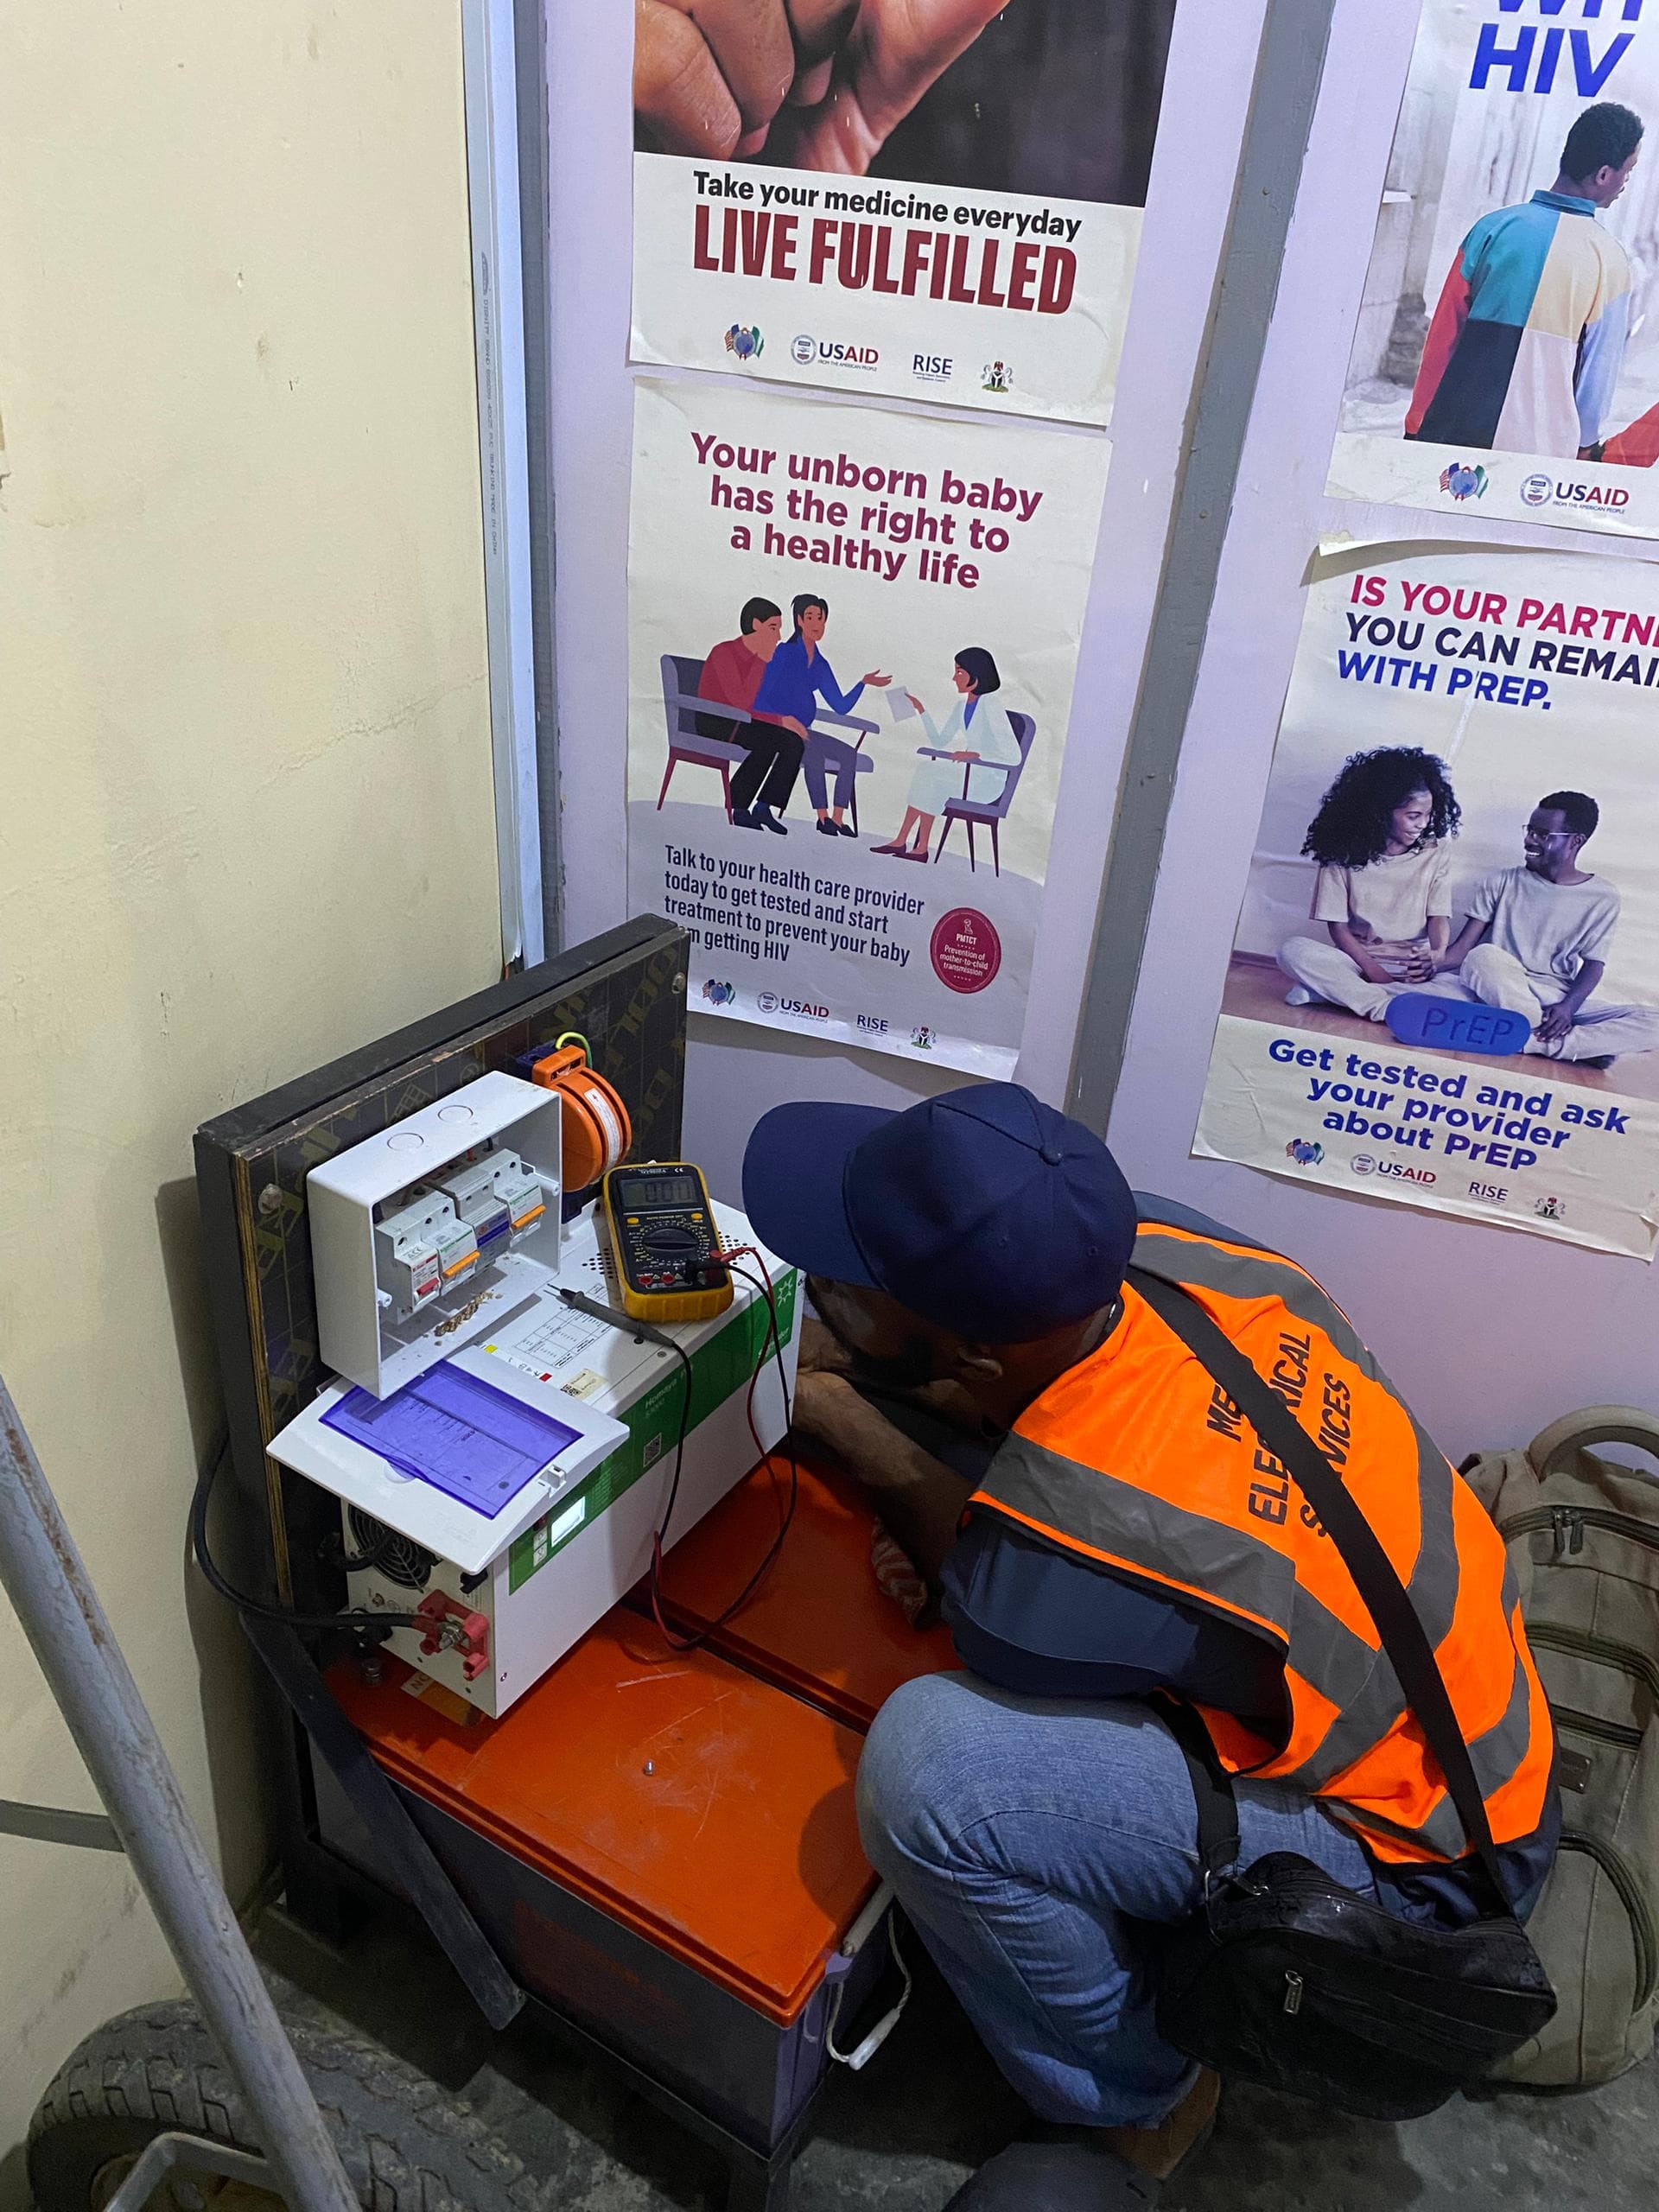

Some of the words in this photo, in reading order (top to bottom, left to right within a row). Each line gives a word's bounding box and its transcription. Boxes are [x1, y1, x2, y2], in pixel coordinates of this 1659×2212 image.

[1469, 23, 1636, 98] HIV
[694, 171, 753, 200] Take
[760, 181, 819, 207] your
[825, 190, 949, 222] medicine
[954, 206, 1082, 243] everyday
[694, 205, 798, 281] LIVE
[809, 218, 1077, 315] FULFILLED
[820, 342, 879, 364] USAID
[913, 354, 953, 375] RISE
[691, 433, 777, 474] Your
[788, 454, 928, 499] unborn
[941, 470, 1043, 522] baby
[1555, 482, 1630, 506] USAID
[1579, 504, 1605, 512] AMERICAN
[711, 474, 773, 515] has
[787, 489, 849, 527] the
[861, 501, 956, 545] right
[969, 518, 1009, 553] to
[731, 524, 750, 550] a
[764, 522, 907, 582] healthy
[919, 549, 980, 588] life
[1350, 574, 1387, 607] IS
[1401, 581, 1508, 626] YOUR
[1338, 649, 1438, 692] WITH
[1446, 668, 1552, 710] PREP.
[1346, 612, 1425, 652] YOU
[1435, 626, 1520, 667] CAN
[1529, 640, 1659, 688] REMAI
[664, 871, 709, 899] today
[712, 880, 728, 899] to
[731, 887, 758, 906] get
[760, 890, 810, 917] tested
[814, 904, 845, 925] and
[848, 911, 888, 934] start
[665, 844, 696, 868] Talk
[699, 853, 715, 872] to
[719, 860, 755, 880] your
[760, 863, 810, 892] health
[814, 878, 850, 899] care
[854, 887, 925, 915] provider
[664, 895, 743, 928] treatment
[746, 912, 761, 931] to
[765, 919, 828, 945] prevent
[830, 933, 868, 954] your
[870, 937, 910, 968] baby
[704, 931, 760, 960] getting
[764, 940, 790, 962] HIV
[944, 944, 977, 959] Prevention
[956, 933, 977, 945] PMTCT
[944, 962, 982, 977] transmission
[781, 998, 830, 1018] USAID
[857, 1014, 888, 1033] RISE
[1421, 1007, 1515, 1046] PrEP
[1268, 1039, 1334, 1071] Get
[1346, 1053, 1467, 1099] tested
[1476, 1083, 1553, 1117] and
[1560, 1098, 1630, 1135] ask
[1307, 1077, 1395, 1112] your
[1402, 1096, 1571, 1151] provider
[1323, 1109, 1433, 1152] about
[1444, 1137, 1537, 1171] PrEP
[1378, 1161, 1437, 1184] USAID
[1469, 1182, 1509, 1201] RISE
[1300, 1373, 1351, 1538] SVICES
